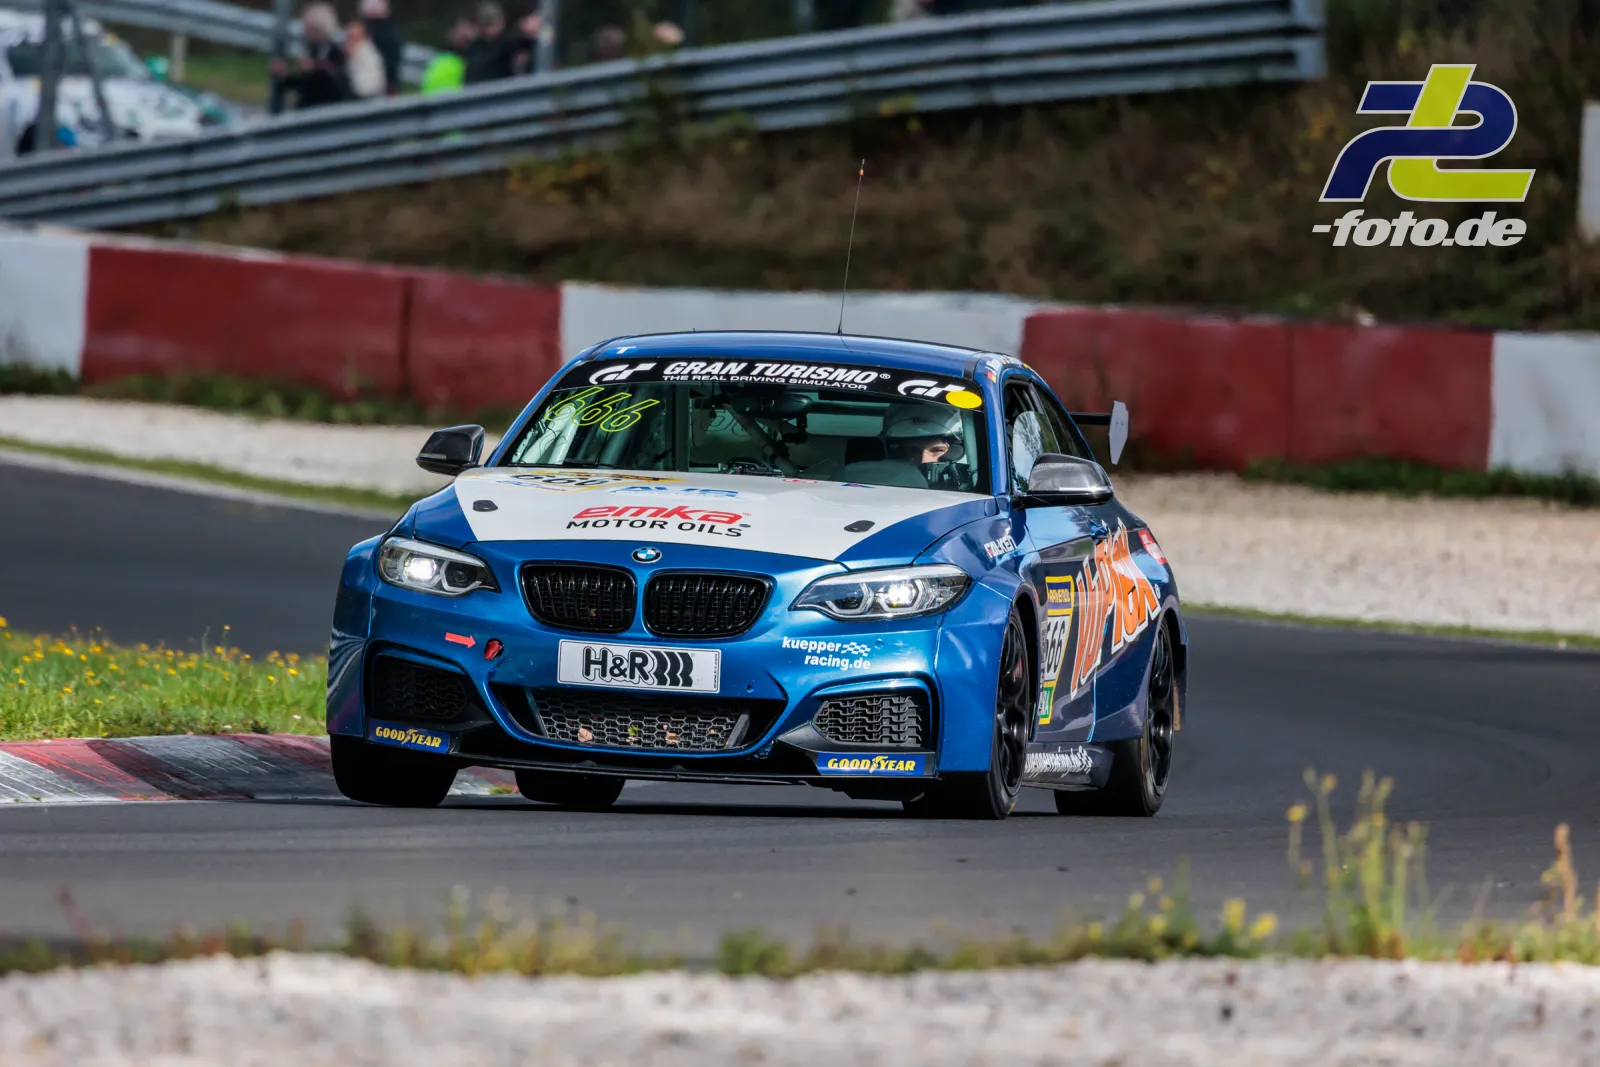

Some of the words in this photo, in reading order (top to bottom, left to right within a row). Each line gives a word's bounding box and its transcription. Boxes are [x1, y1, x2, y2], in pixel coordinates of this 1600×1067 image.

[663, 361, 748, 375] GRAN
[788, 379, 868, 390] SIMULATOR
[545, 386, 661, 432] 666
[572, 505, 743, 525] emka
[566, 519, 669, 530] MOTOR
[677, 521, 743, 538] OILS
[782, 636, 842, 654] kuepper
[583, 646, 655, 685] H&R
[804, 654, 871, 671] racing.de
[375, 726, 442, 748] GOODYEAR
[827, 755, 916, 774] GOODYEAR
